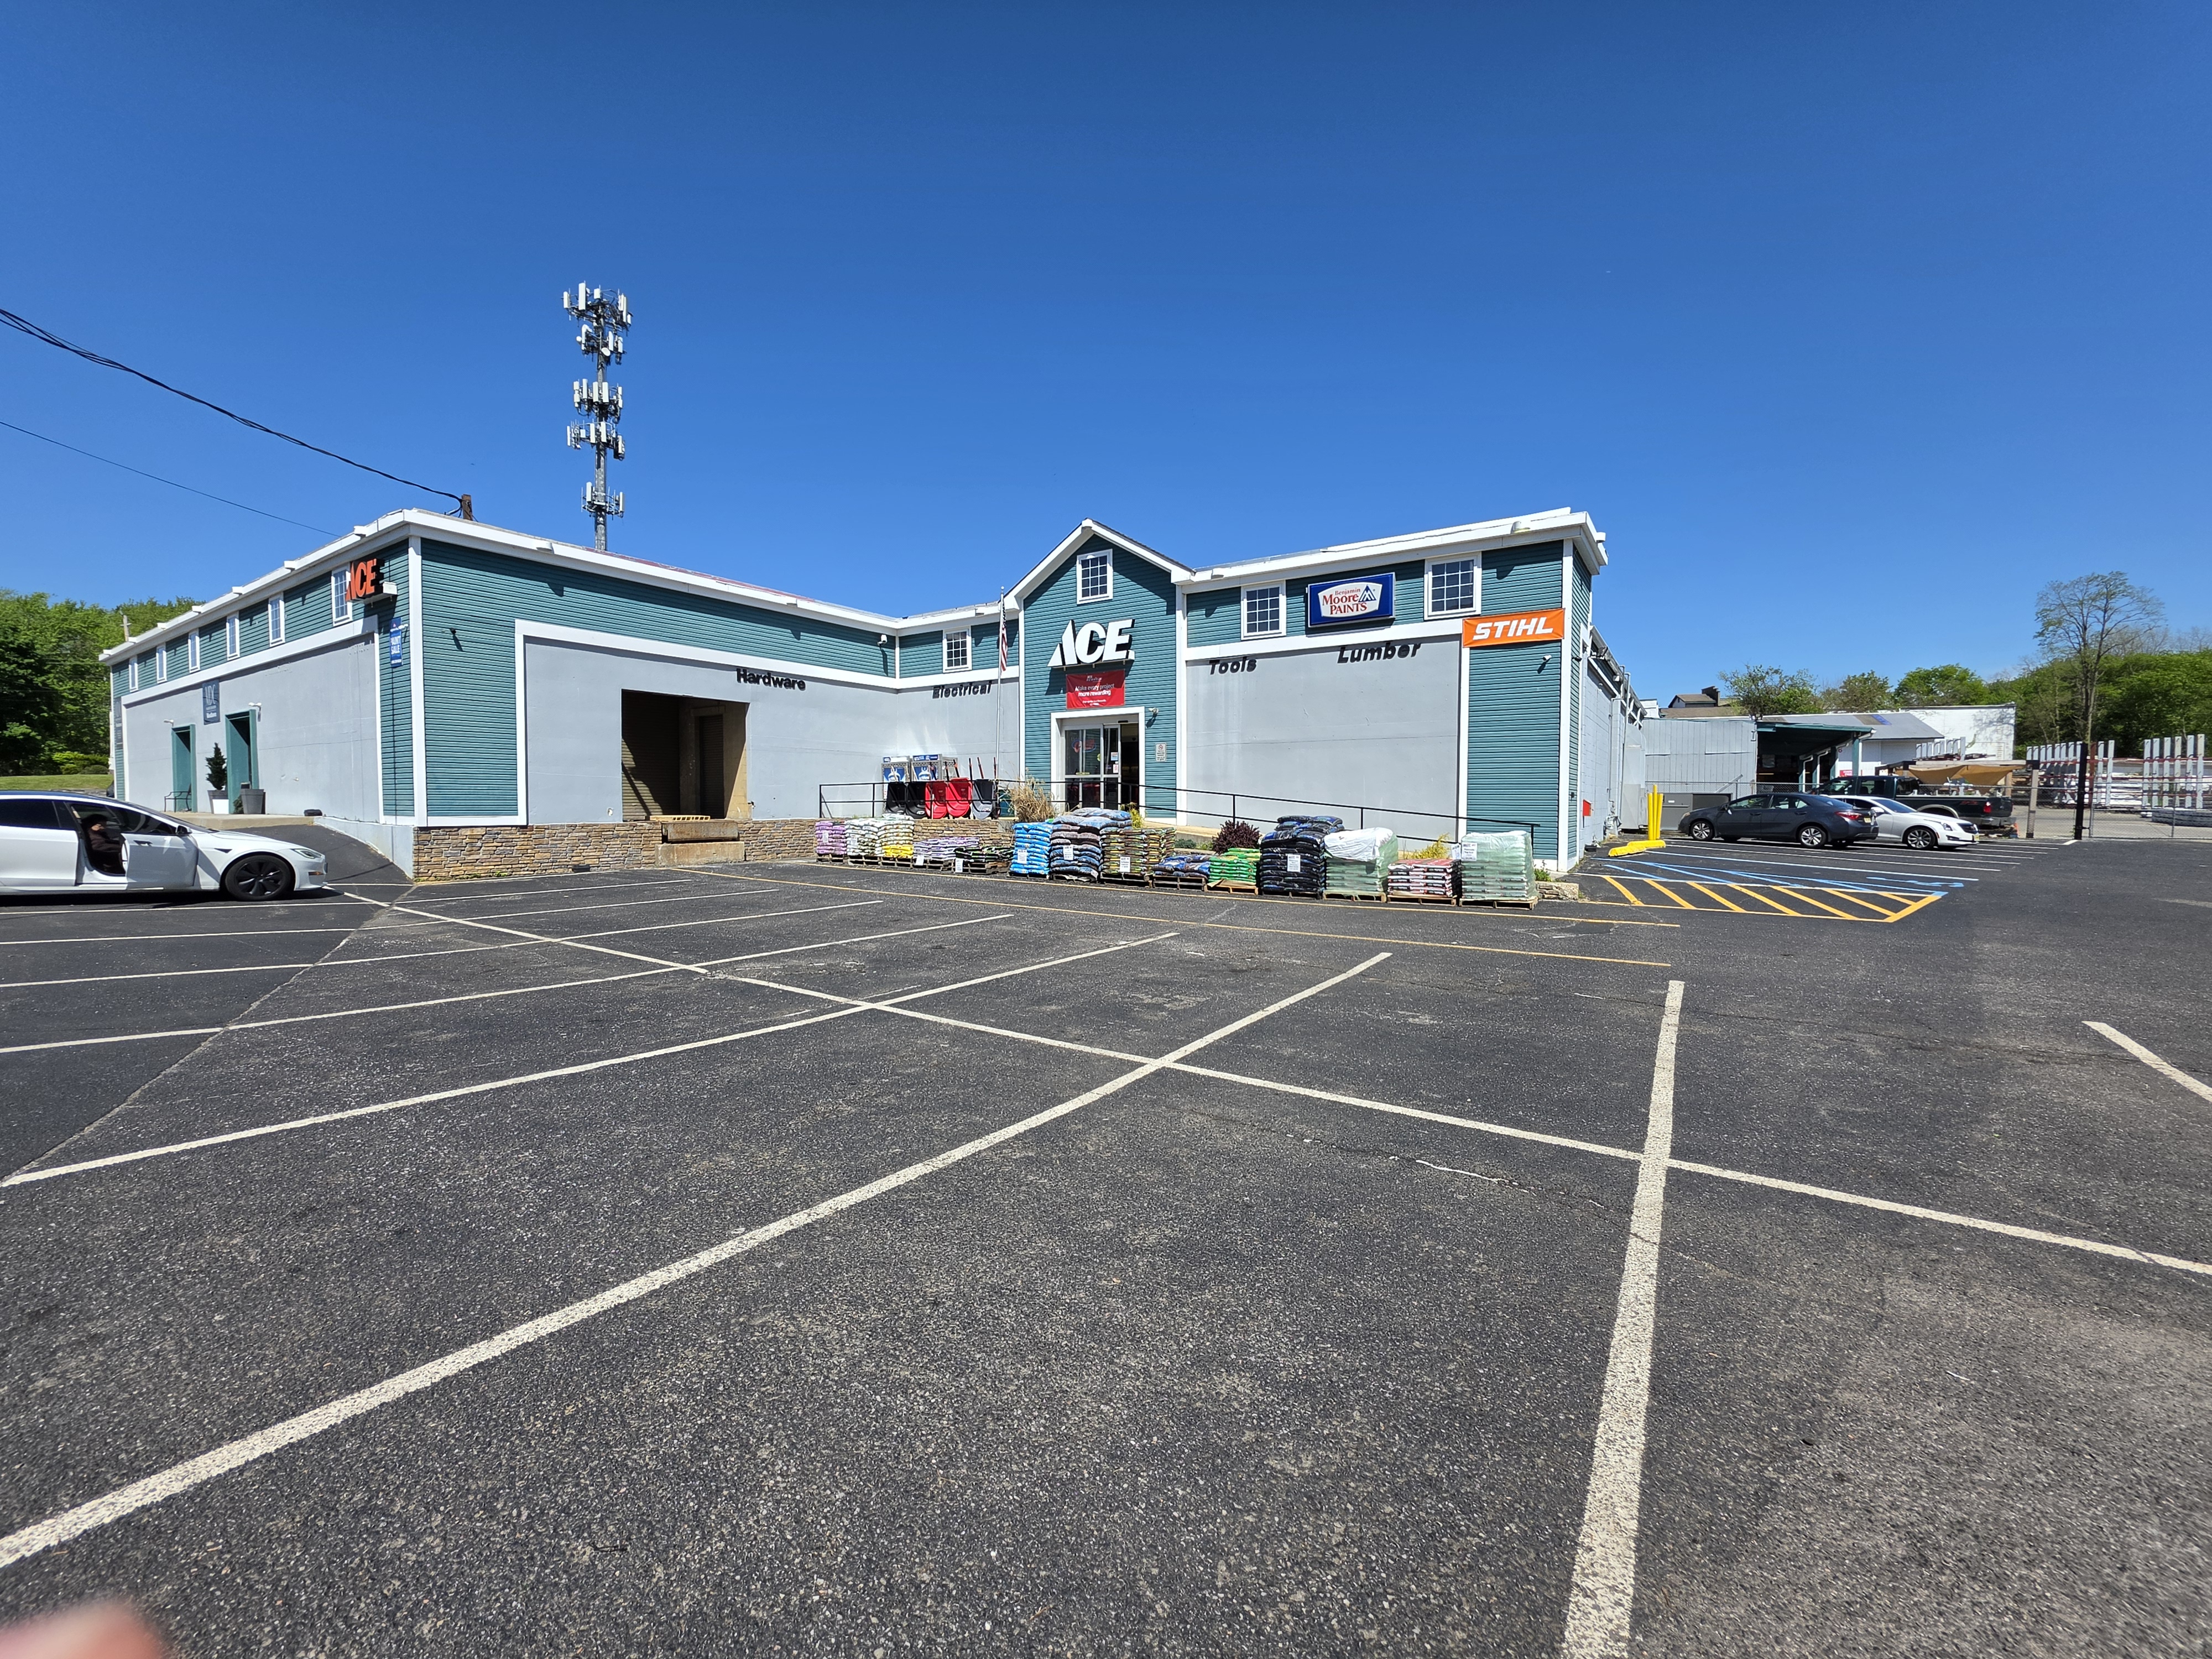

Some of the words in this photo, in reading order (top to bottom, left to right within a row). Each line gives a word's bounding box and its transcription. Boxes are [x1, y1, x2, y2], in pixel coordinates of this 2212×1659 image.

[345, 559, 377, 601] ACE
[1322, 594, 1359, 606] Moore
[1330, 602, 1367, 615] PAINTS
[1473, 617, 1553, 640] STIHL
[391, 645, 400, 655] SALE
[1047, 619, 1135, 667] ACE
[1337, 642, 1421, 664] Lumber
[1209, 656, 1257, 675] Tools
[737, 668, 806, 691] Hardware
[932, 681, 992, 699] Electrical
